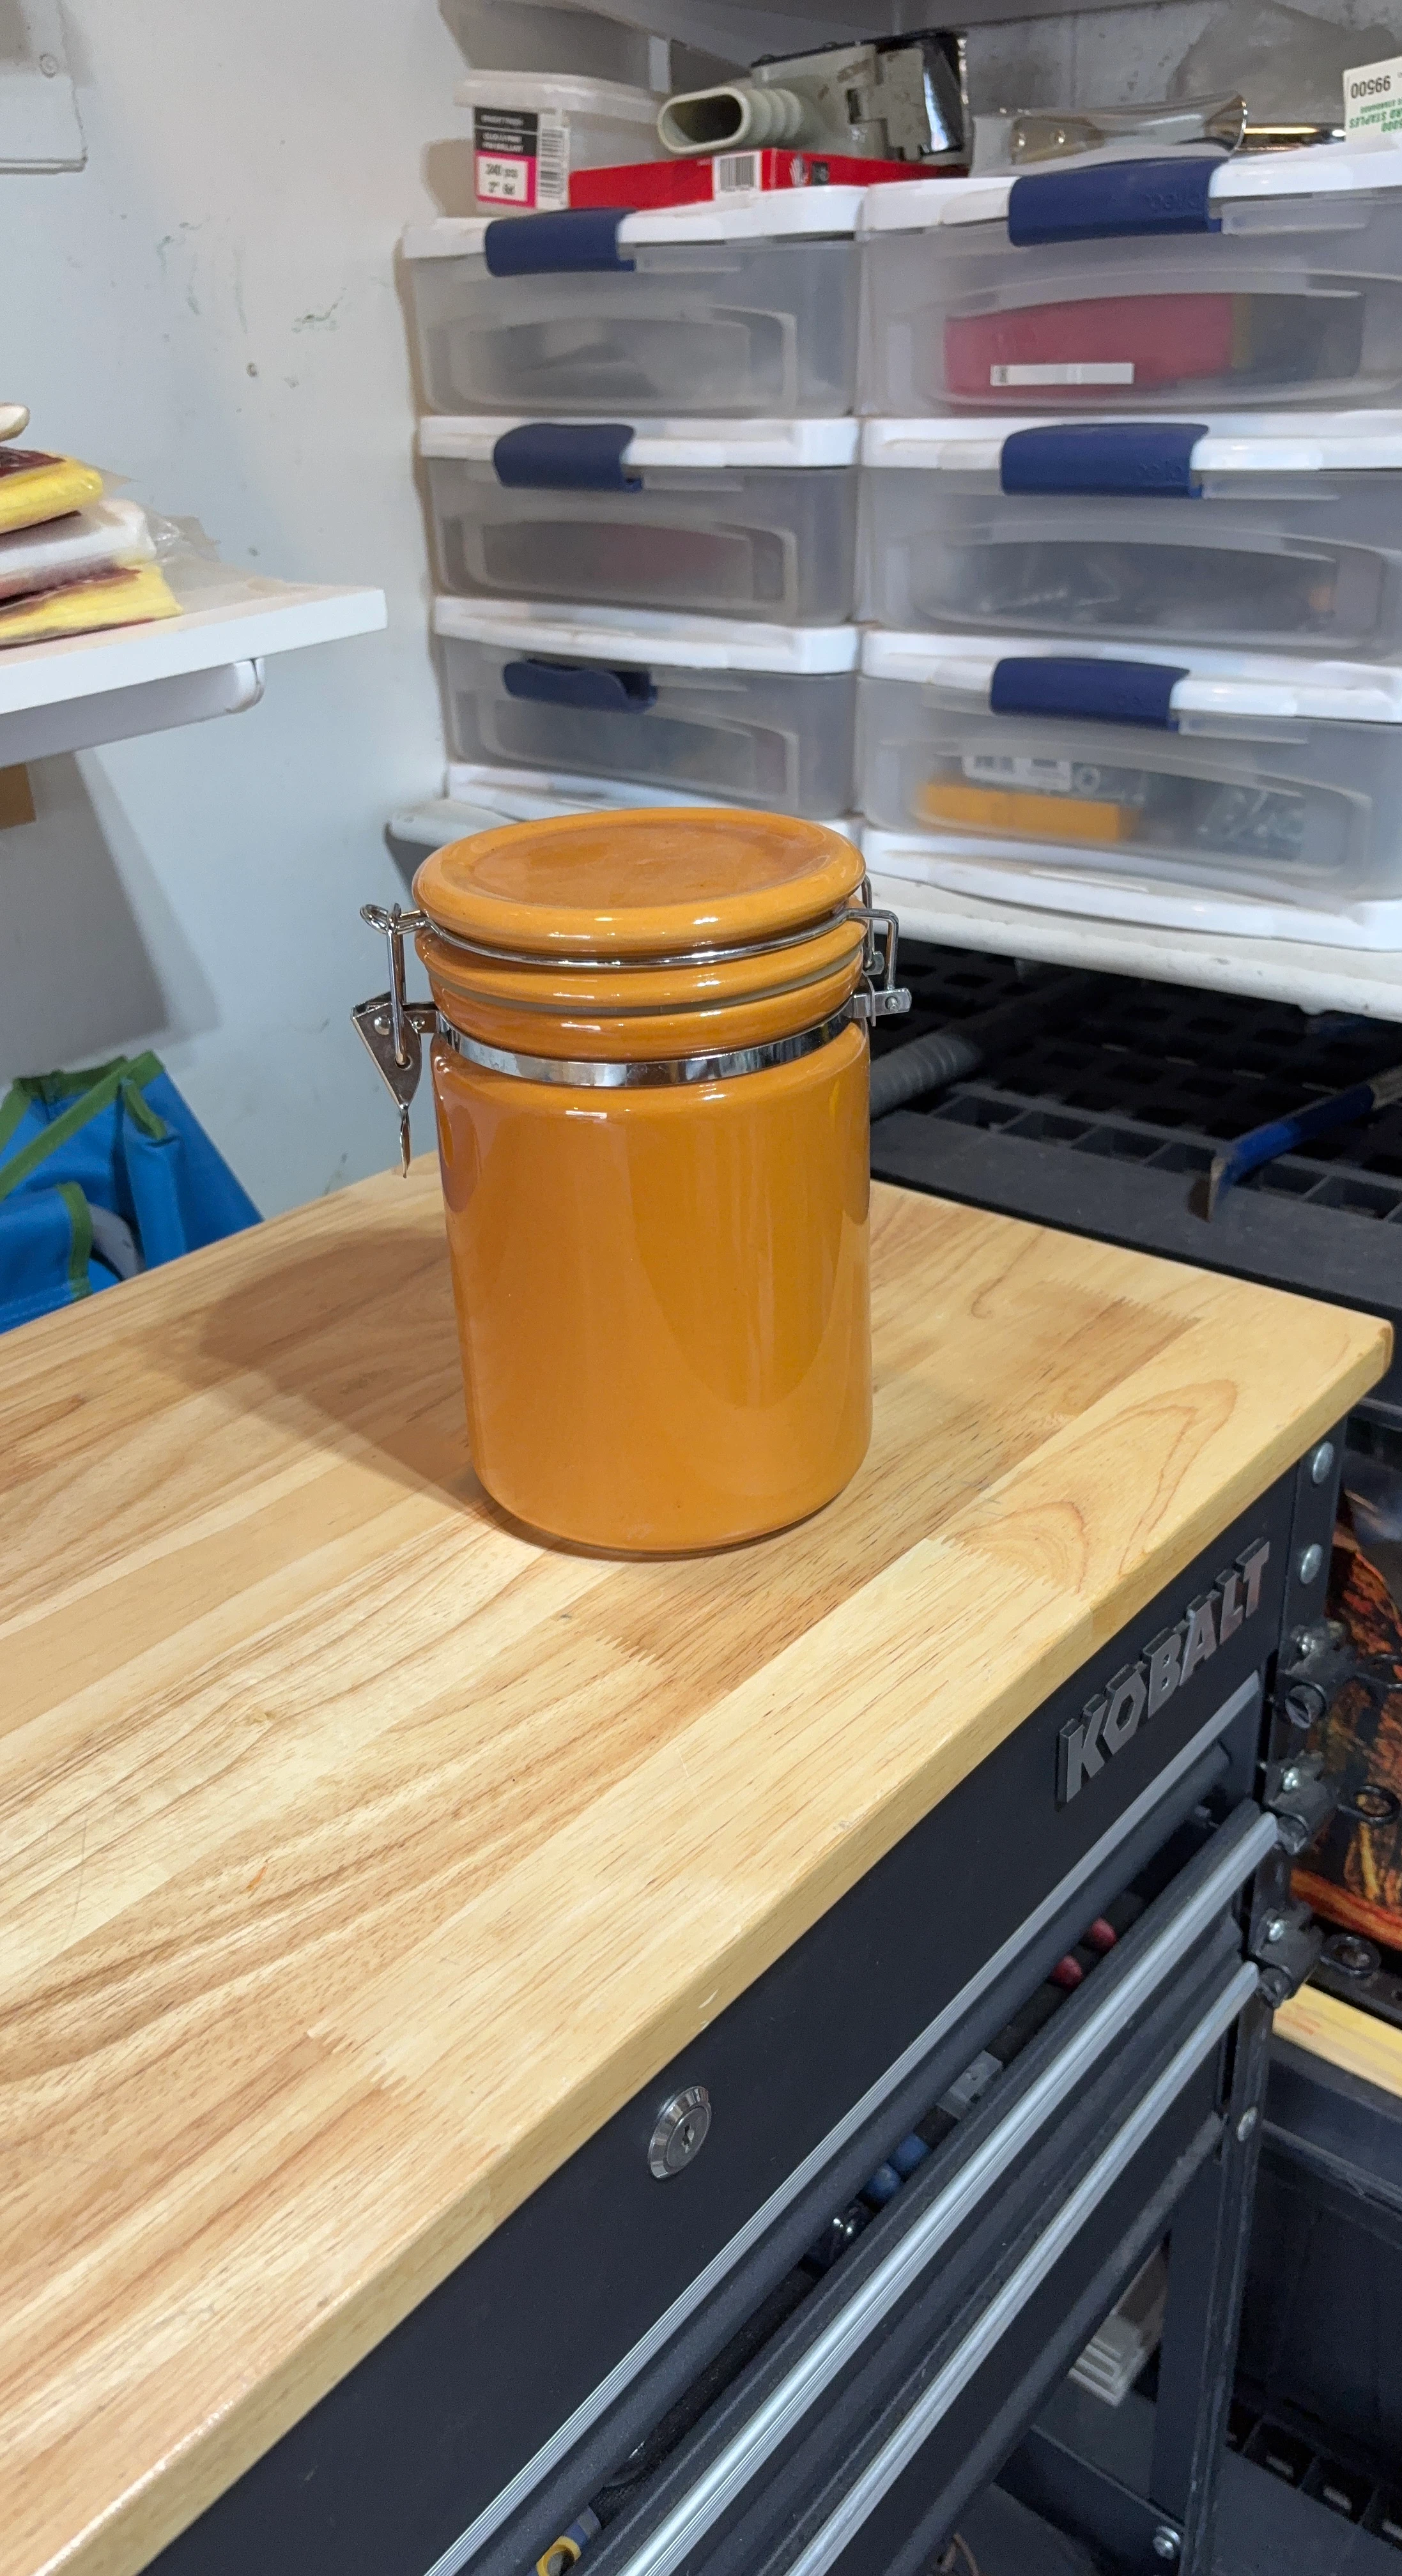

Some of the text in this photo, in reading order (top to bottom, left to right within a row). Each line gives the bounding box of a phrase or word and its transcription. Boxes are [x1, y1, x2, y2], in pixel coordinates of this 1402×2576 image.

[1350, 75, 1391, 98] 99500
[1349, 111, 1386, 128] STAPLES
[1060, 1538, 1270, 1803] KOBALT
